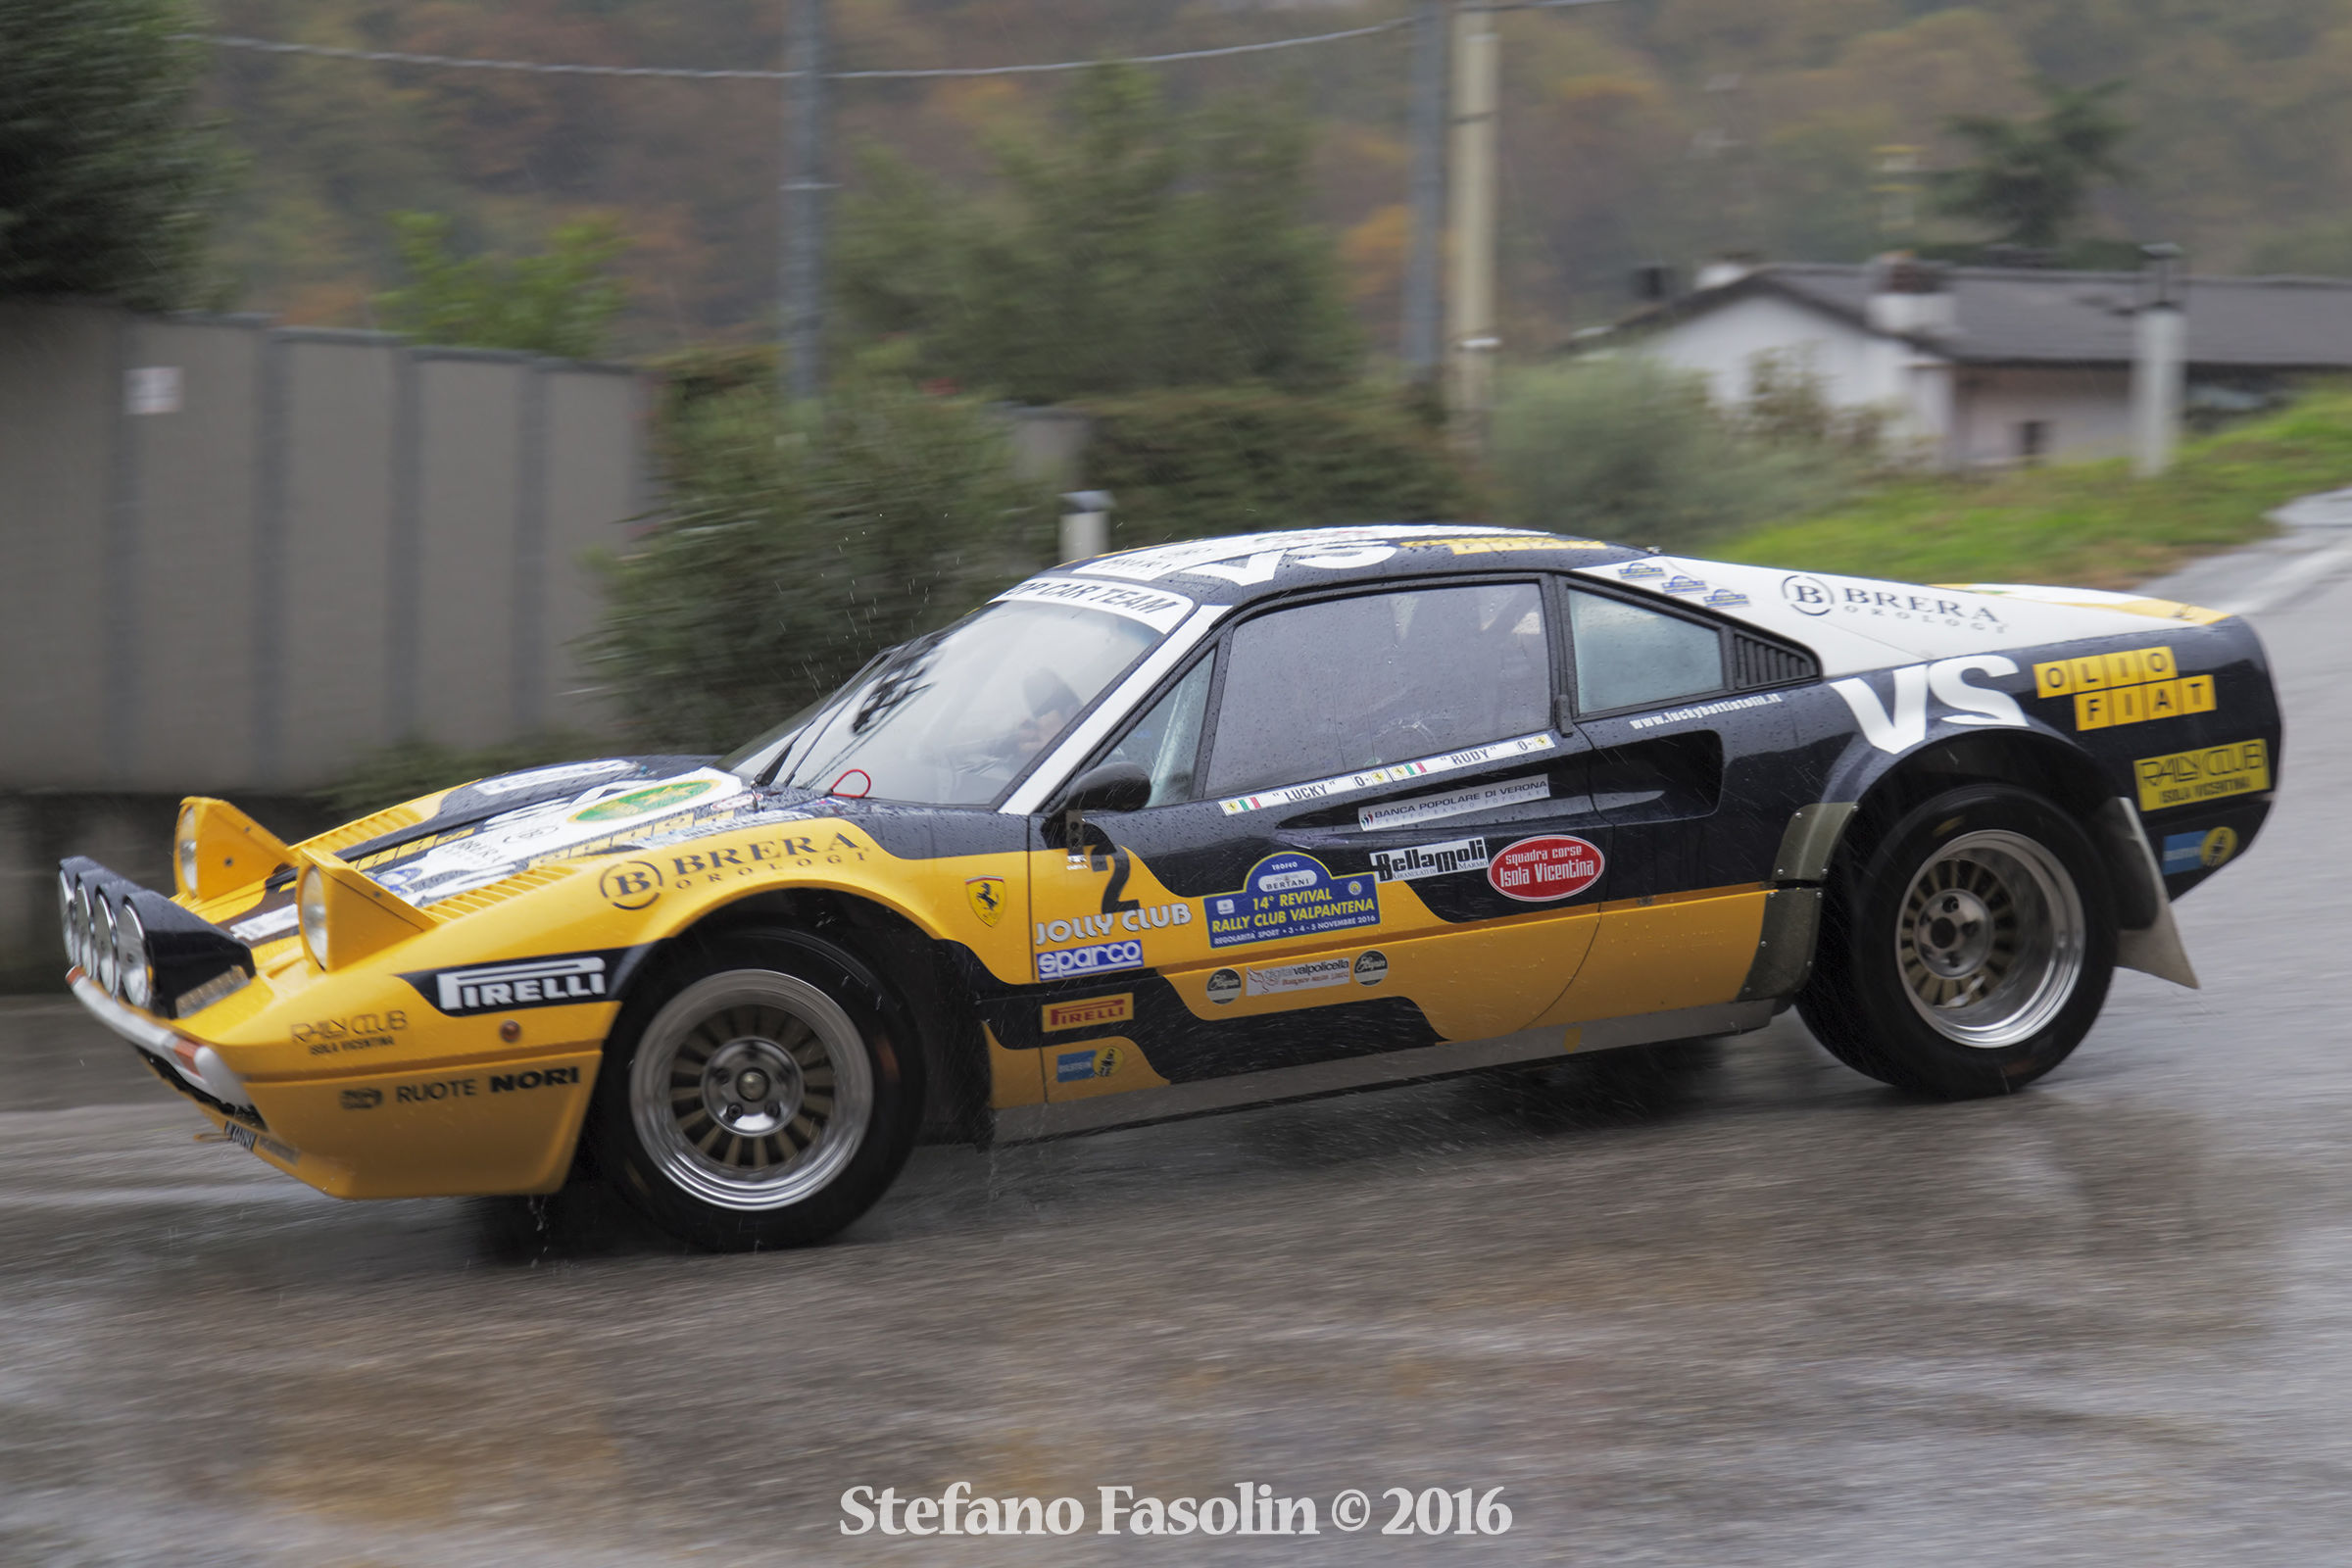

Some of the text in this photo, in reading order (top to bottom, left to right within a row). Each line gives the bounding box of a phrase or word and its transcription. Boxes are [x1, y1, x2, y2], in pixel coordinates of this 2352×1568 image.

[1037, 583, 1102, 599] CAR
[1089, 588, 1179, 613] TEAM
[1843, 587, 2000, 622] BRERA
[2045, 653, 2168, 688] OLIO
[1829, 655, 2030, 755] VS
[2087, 683, 2204, 721] FIAT
[2206, 743, 2267, 776] CLUB
[1375, 780, 1547, 819] BANCA POPOLARE DI VERONA
[672, 832, 859, 875] BRERA
[676, 847, 869, 890] OROLOGI
[1372, 840, 1486, 882] Bellamoli
[1505, 845, 1582, 868] squadra corse
[1091, 843, 1141, 914] 2
[1266, 878, 1310, 891] BERTANI
[1500, 859, 1594, 887] Isola Vicentina
[1212, 898, 1375, 933] RALLY CLUB VALPANTENA
[1279, 888, 1332, 907] REVIVAL
[1036, 903, 1193, 946] JOLLY CLUB
[1318, 918, 1356, 930] NOVEMBRE
[1357, 915, 1375, 924] 2016
[1039, 941, 1141, 978] sparco
[437, 956, 606, 1010] PIRELLI
[1051, 999, 1124, 1025] PIRELLI
[396, 1078, 477, 1103] RUOTE
[491, 1066, 580, 1093] NORI
